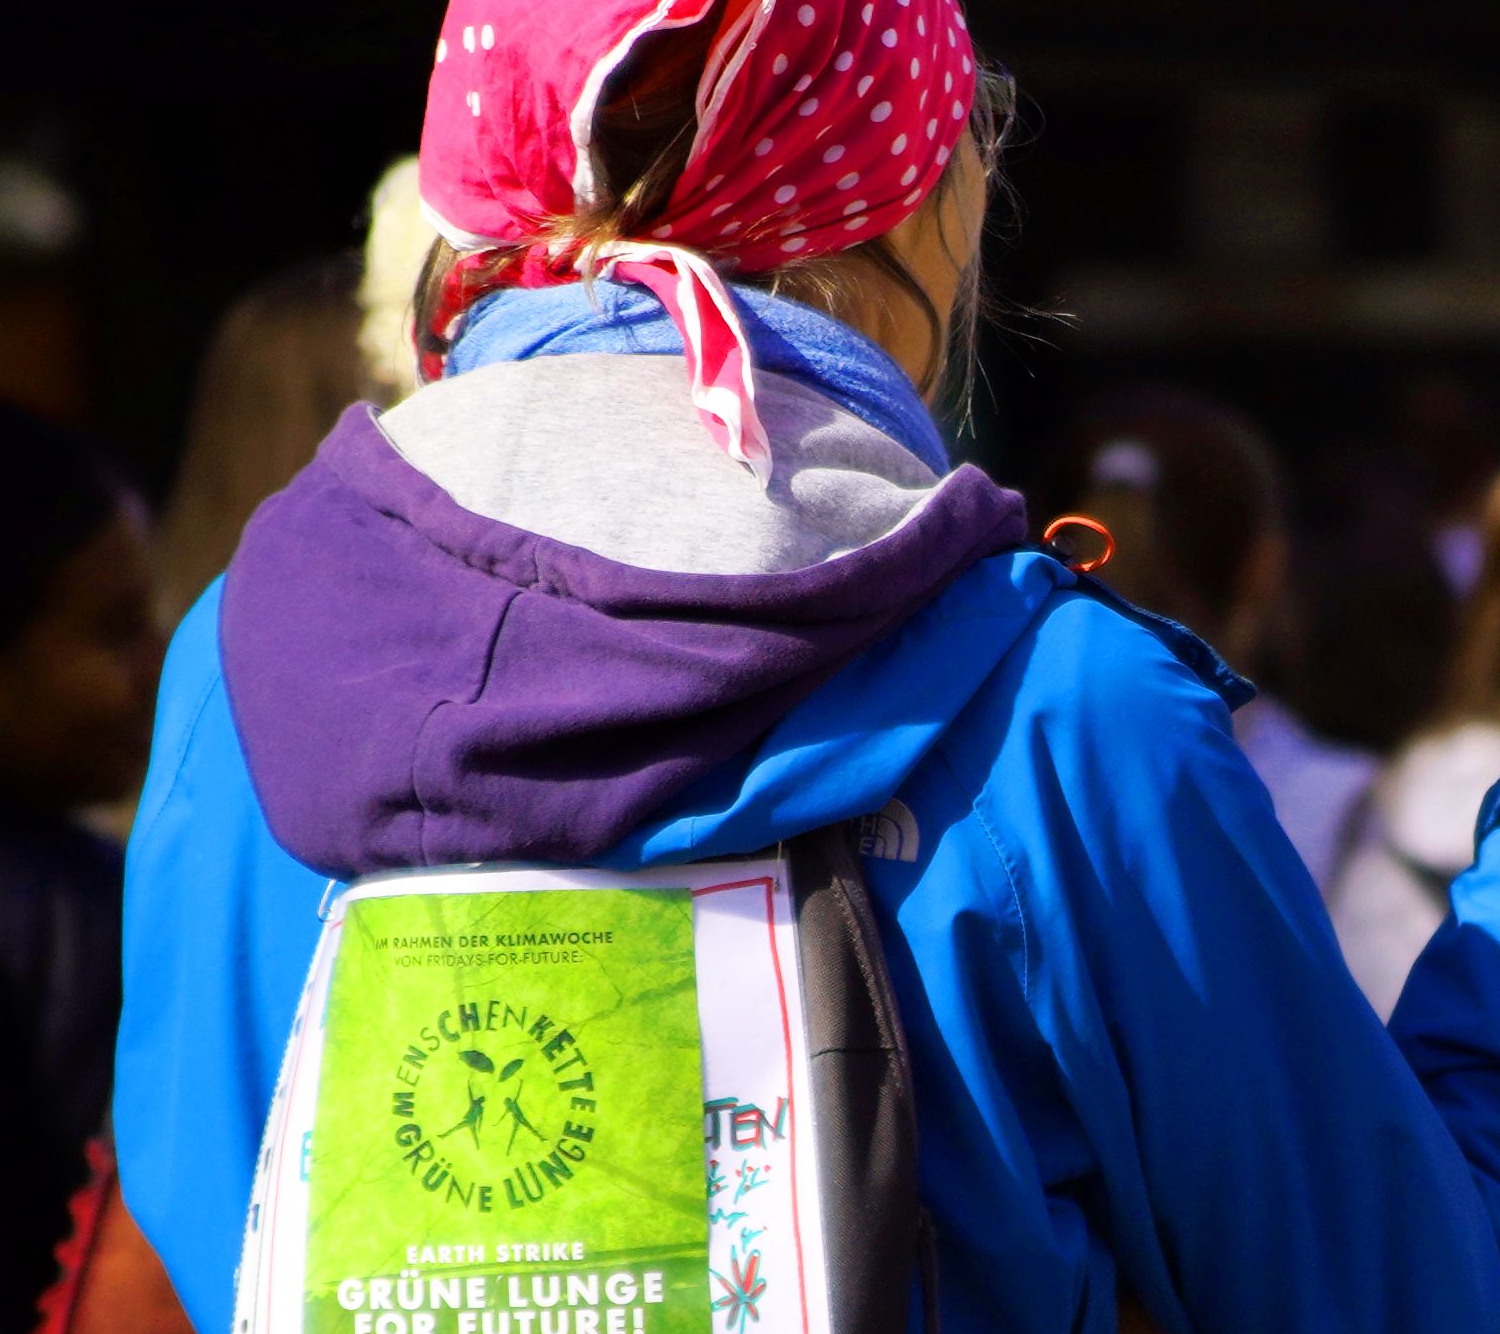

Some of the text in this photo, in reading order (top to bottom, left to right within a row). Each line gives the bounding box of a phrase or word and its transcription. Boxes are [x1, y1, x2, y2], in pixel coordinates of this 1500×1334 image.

[375, 931, 613, 950] IM RAHMEN DER KLIMAWOCHE
[394, 955, 421, 968] VON
[392, 1000, 598, 1118] MENSCHENKETTE
[704, 1096, 789, 1152] TEN
[394, 1123, 493, 1213] GRÜNE
[503, 1120, 596, 1209] LUNGE
[406, 1242, 584, 1265] EARTH STRIKE
[336, 1269, 664, 1311] GRÜNE LUNGE
